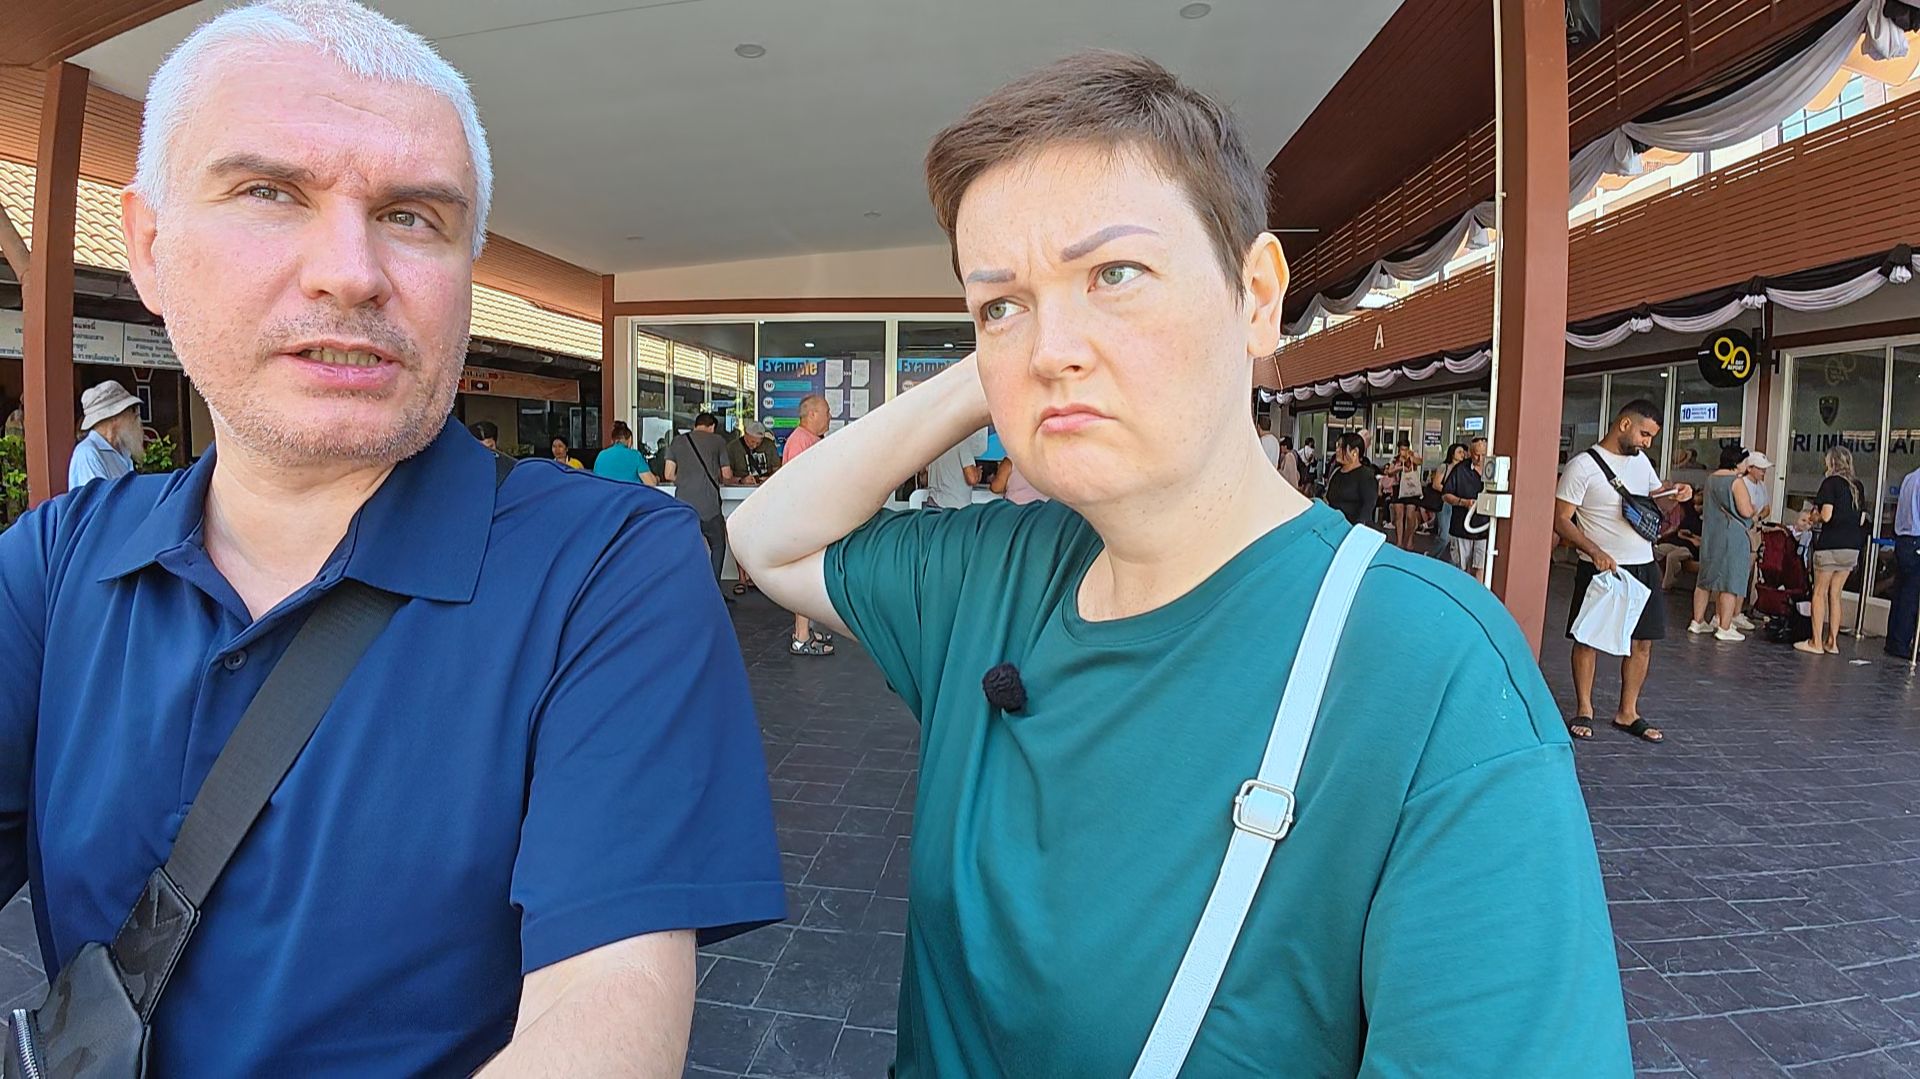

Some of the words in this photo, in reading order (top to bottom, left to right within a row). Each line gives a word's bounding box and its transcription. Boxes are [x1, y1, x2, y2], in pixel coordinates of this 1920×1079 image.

[1374, 324, 1384, 350] A
[762, 359, 818, 378] Example
[1714, 336, 1751, 379] 90
[1682, 407, 1691, 420] 10
[1707, 406, 1715, 419] 11
